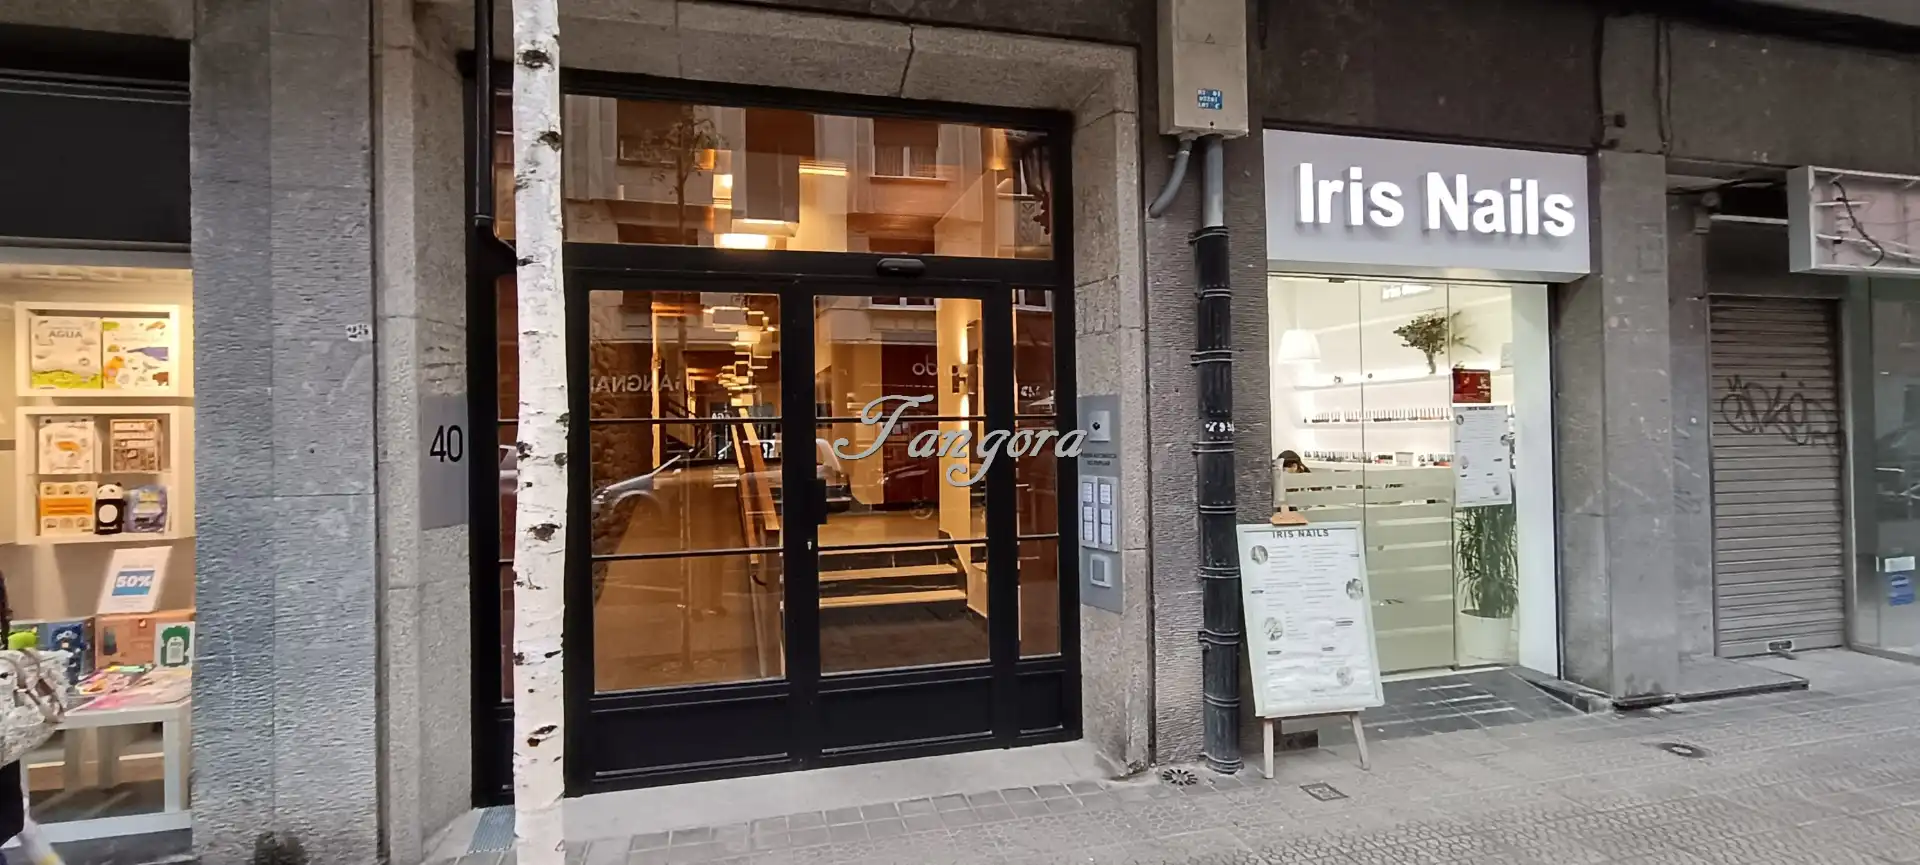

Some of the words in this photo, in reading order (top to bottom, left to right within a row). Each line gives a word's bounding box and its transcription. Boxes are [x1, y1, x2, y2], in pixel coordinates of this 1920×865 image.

[1298, 162, 1404, 227] Iris
[1426, 172, 1576, 237] Nails
[48, 330, 83, 338] AGUA
[430, 425, 463, 463] 40
[1272, 530, 1294, 539] IRIS
[1299, 528, 1329, 538] NAILS
[115, 575, 152, 588] 50%
